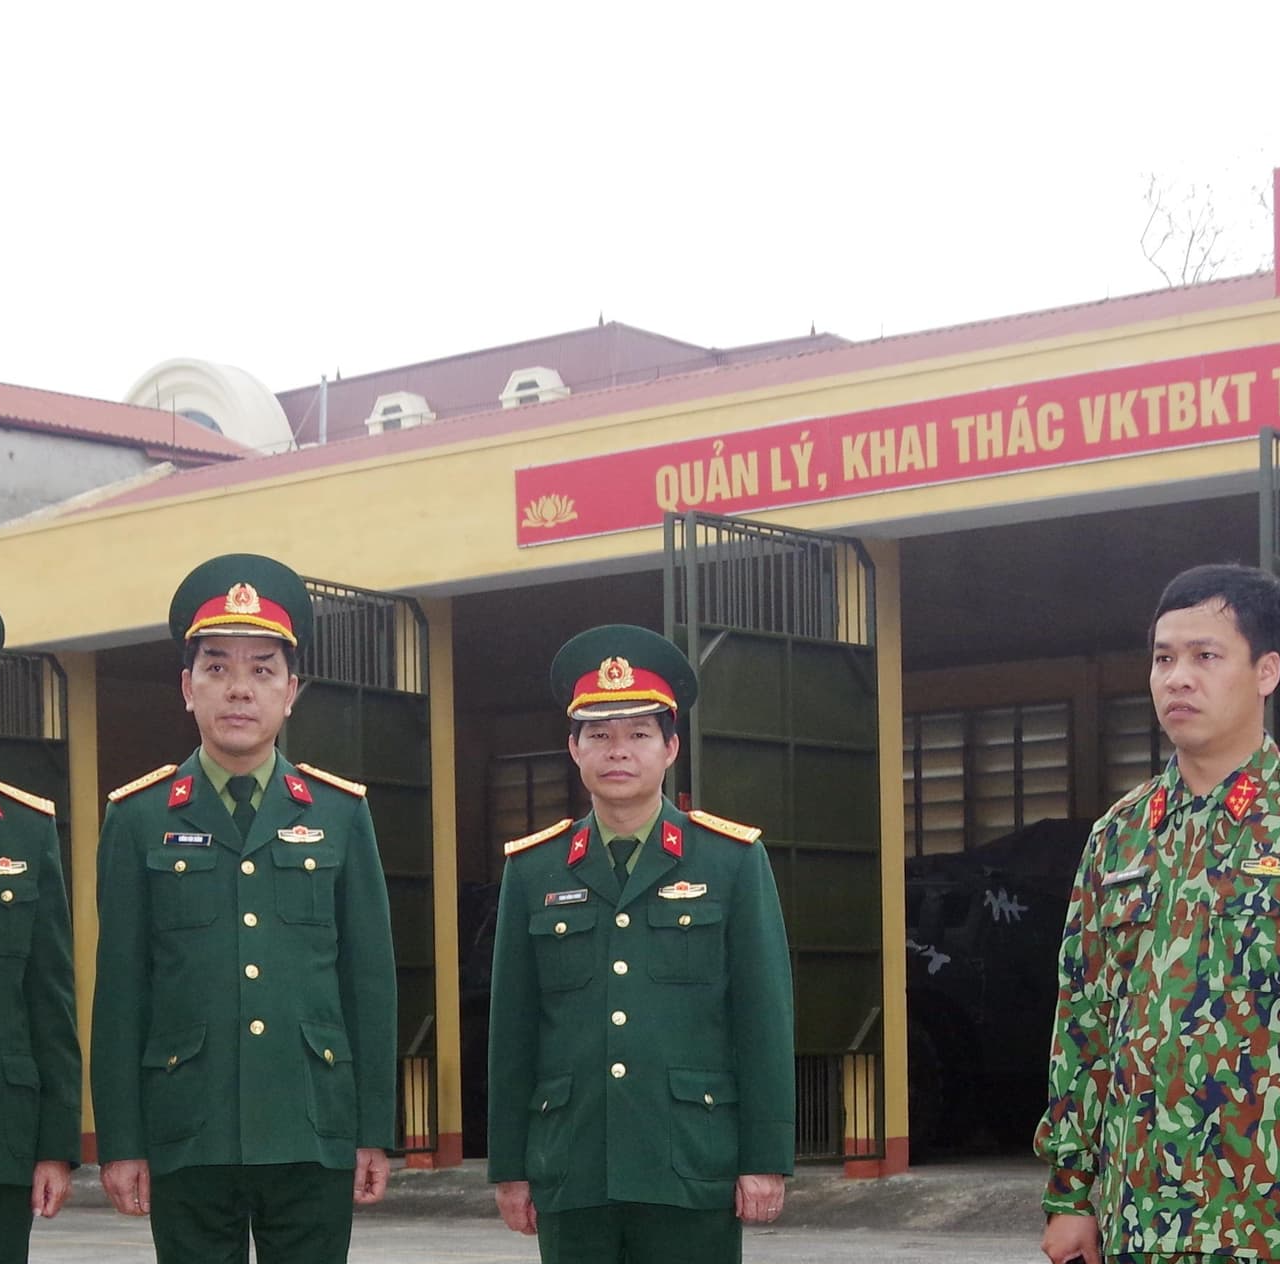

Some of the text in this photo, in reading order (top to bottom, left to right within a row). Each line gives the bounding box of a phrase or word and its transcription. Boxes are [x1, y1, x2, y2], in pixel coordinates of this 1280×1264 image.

[655, 440, 759, 512] QUẢN
[770, 430, 827, 491] LÝ,
[841, 422, 939, 481] KHAI
[951, 395, 1065, 464] THÁC
[1079, 372, 1257, 444] VKTBKT
